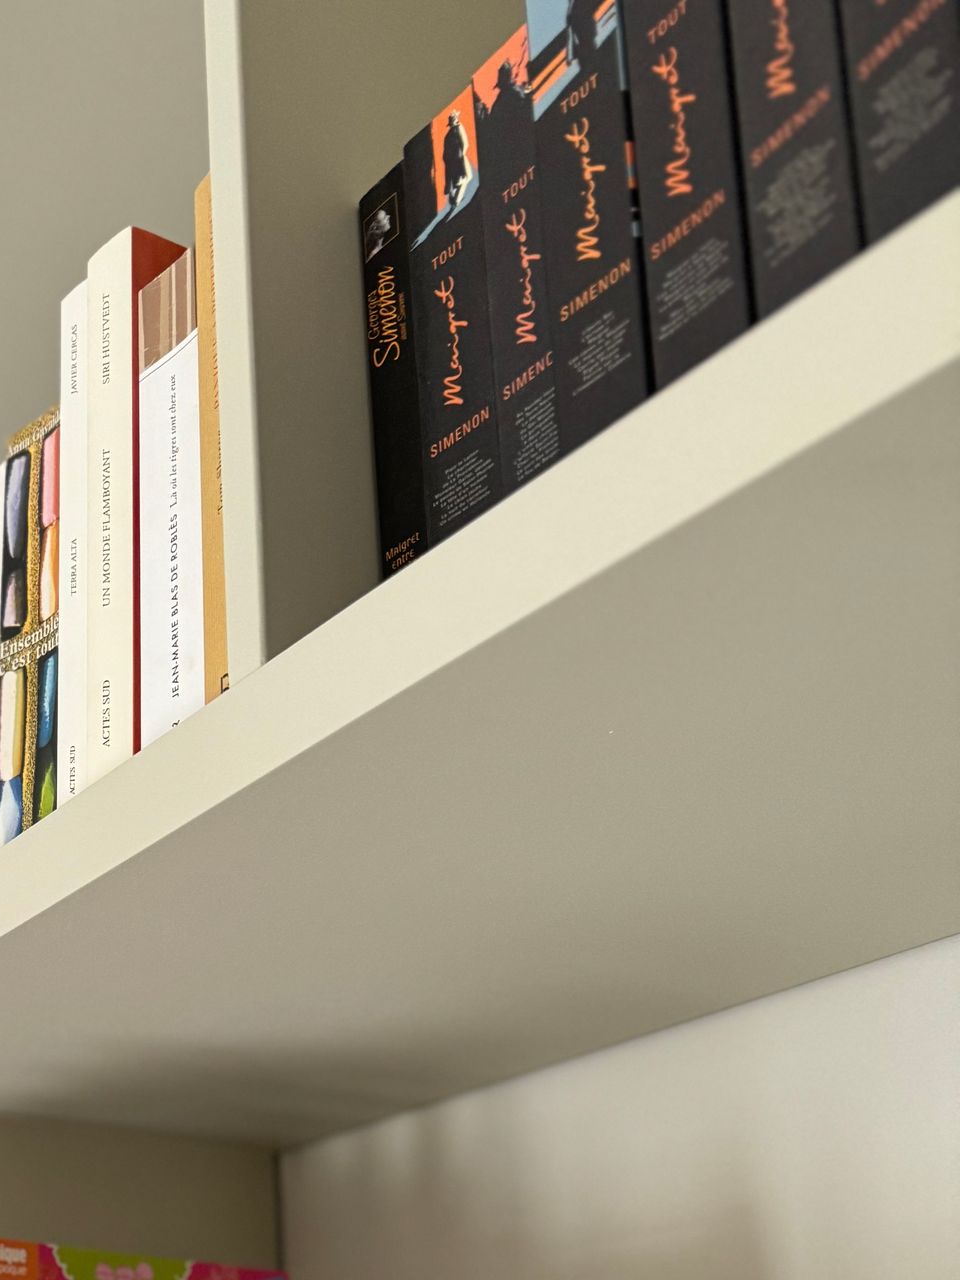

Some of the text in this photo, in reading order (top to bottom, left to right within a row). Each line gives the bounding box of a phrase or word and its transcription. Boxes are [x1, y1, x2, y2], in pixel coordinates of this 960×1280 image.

[647, 0, 687, 44] TOUT
[559, 72, 599, 114] TOUT
[651, 46, 696, 197] Maigret
[501, 164, 536, 204] TOUT
[563, 117, 607, 262] Maigret
[649, 188, 726, 261] SIMENON
[431, 235, 464, 270] TOUT
[505, 208, 542, 345] Maigret
[559, 257, 632, 323] SIMENON
[368, 289, 380, 340] Georges
[373, 265, 400, 369] Simenon
[102, 292, 110, 385] SIRI HUSTVEDT
[434, 275, 469, 407] Maigret
[70, 362, 79, 395] JAVIER
[170, 373, 178, 391] eux
[168, 392, 178, 413] chez
[169, 415, 178, 434] sont
[169, 436, 180, 462] tigres
[429, 406, 490, 459] SIMENON
[170, 463, 178, 477] les
[102, 449, 111, 607] UN MONDE FLAMBOYANT
[385, 532, 420, 562] Maigret
[392, 549, 415, 569] entre
[168, 513, 180, 698] JEAN-MARIE BLAS DE ROBLÈS
[0, 615, 59, 659] Ensemble
[36, 633, 59, 660] tout
[102, 679, 111, 747] ACTES SUD
